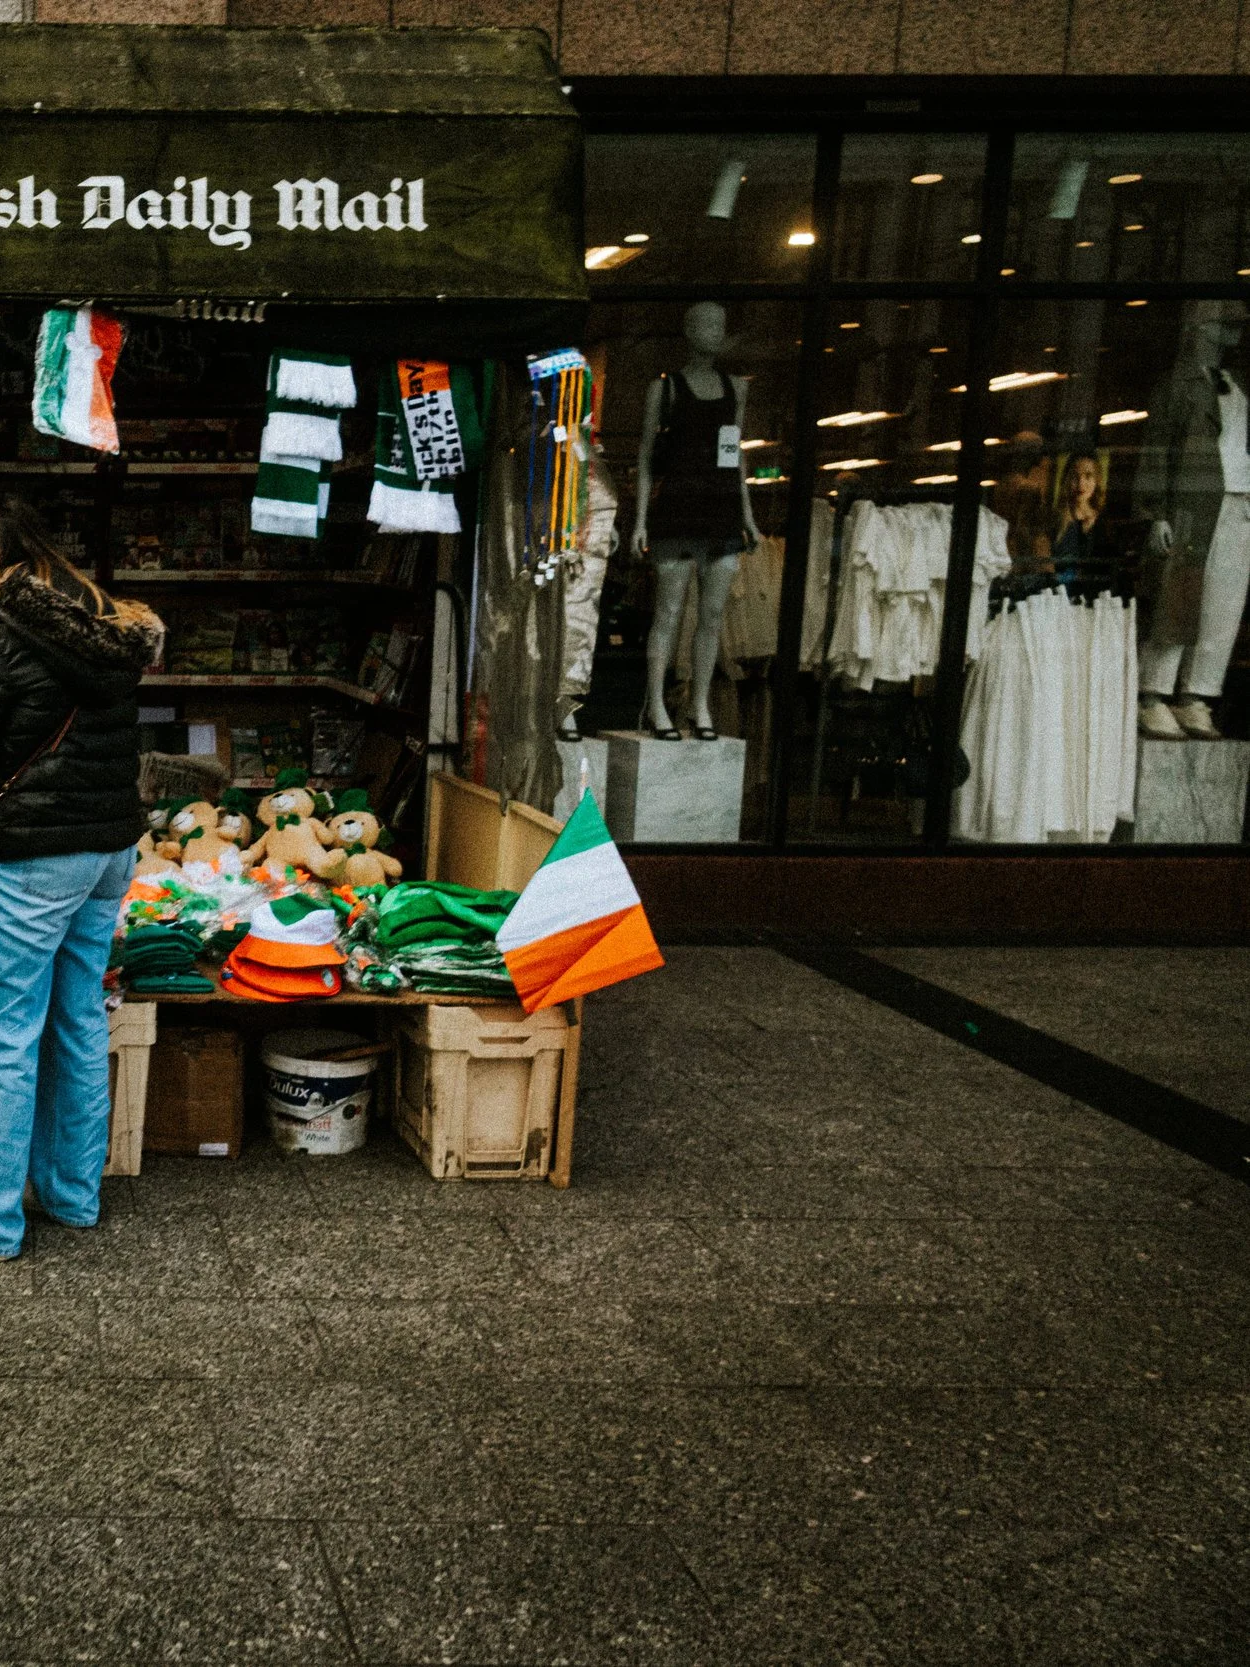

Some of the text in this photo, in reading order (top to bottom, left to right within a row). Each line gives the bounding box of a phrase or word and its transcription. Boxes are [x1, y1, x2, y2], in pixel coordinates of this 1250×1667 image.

[77, 174, 254, 251] Daily
[272, 176, 430, 232] Mail
[404, 363, 426, 411] Day
